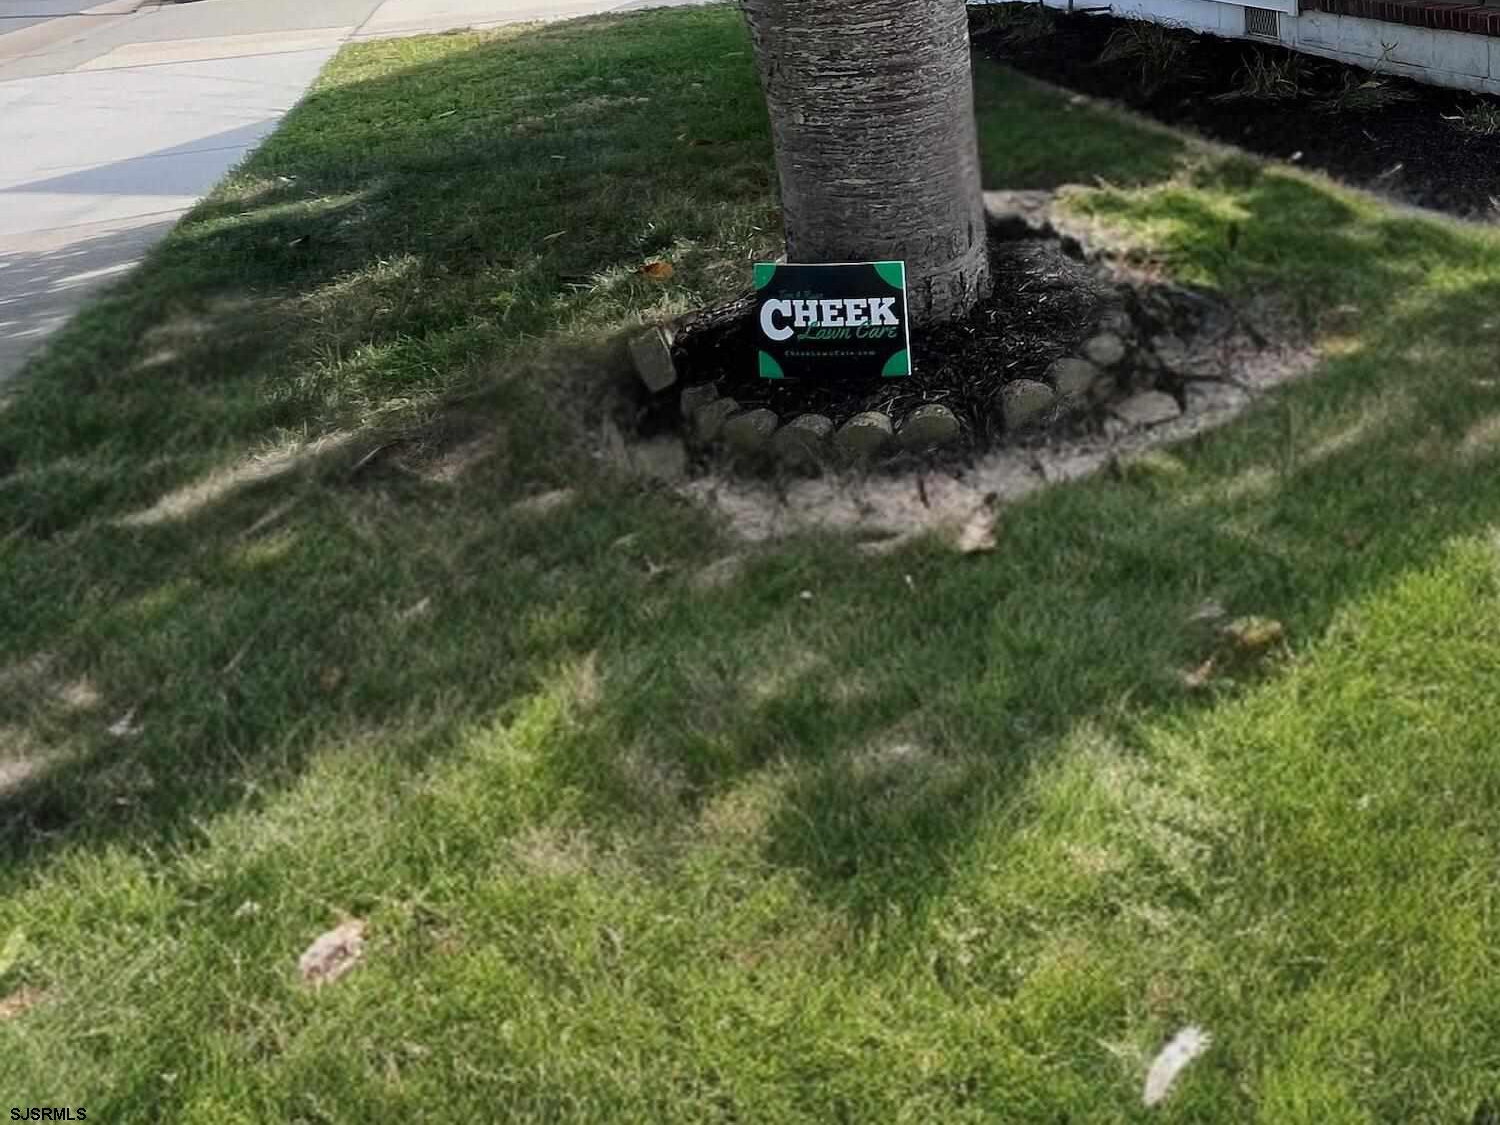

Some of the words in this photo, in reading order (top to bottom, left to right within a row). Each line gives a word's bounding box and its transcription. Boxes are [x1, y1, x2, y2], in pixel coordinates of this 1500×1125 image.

[760, 298, 899, 341] CHEEK
[798, 321, 850, 340] Lawn
[856, 320, 897, 339] Care
